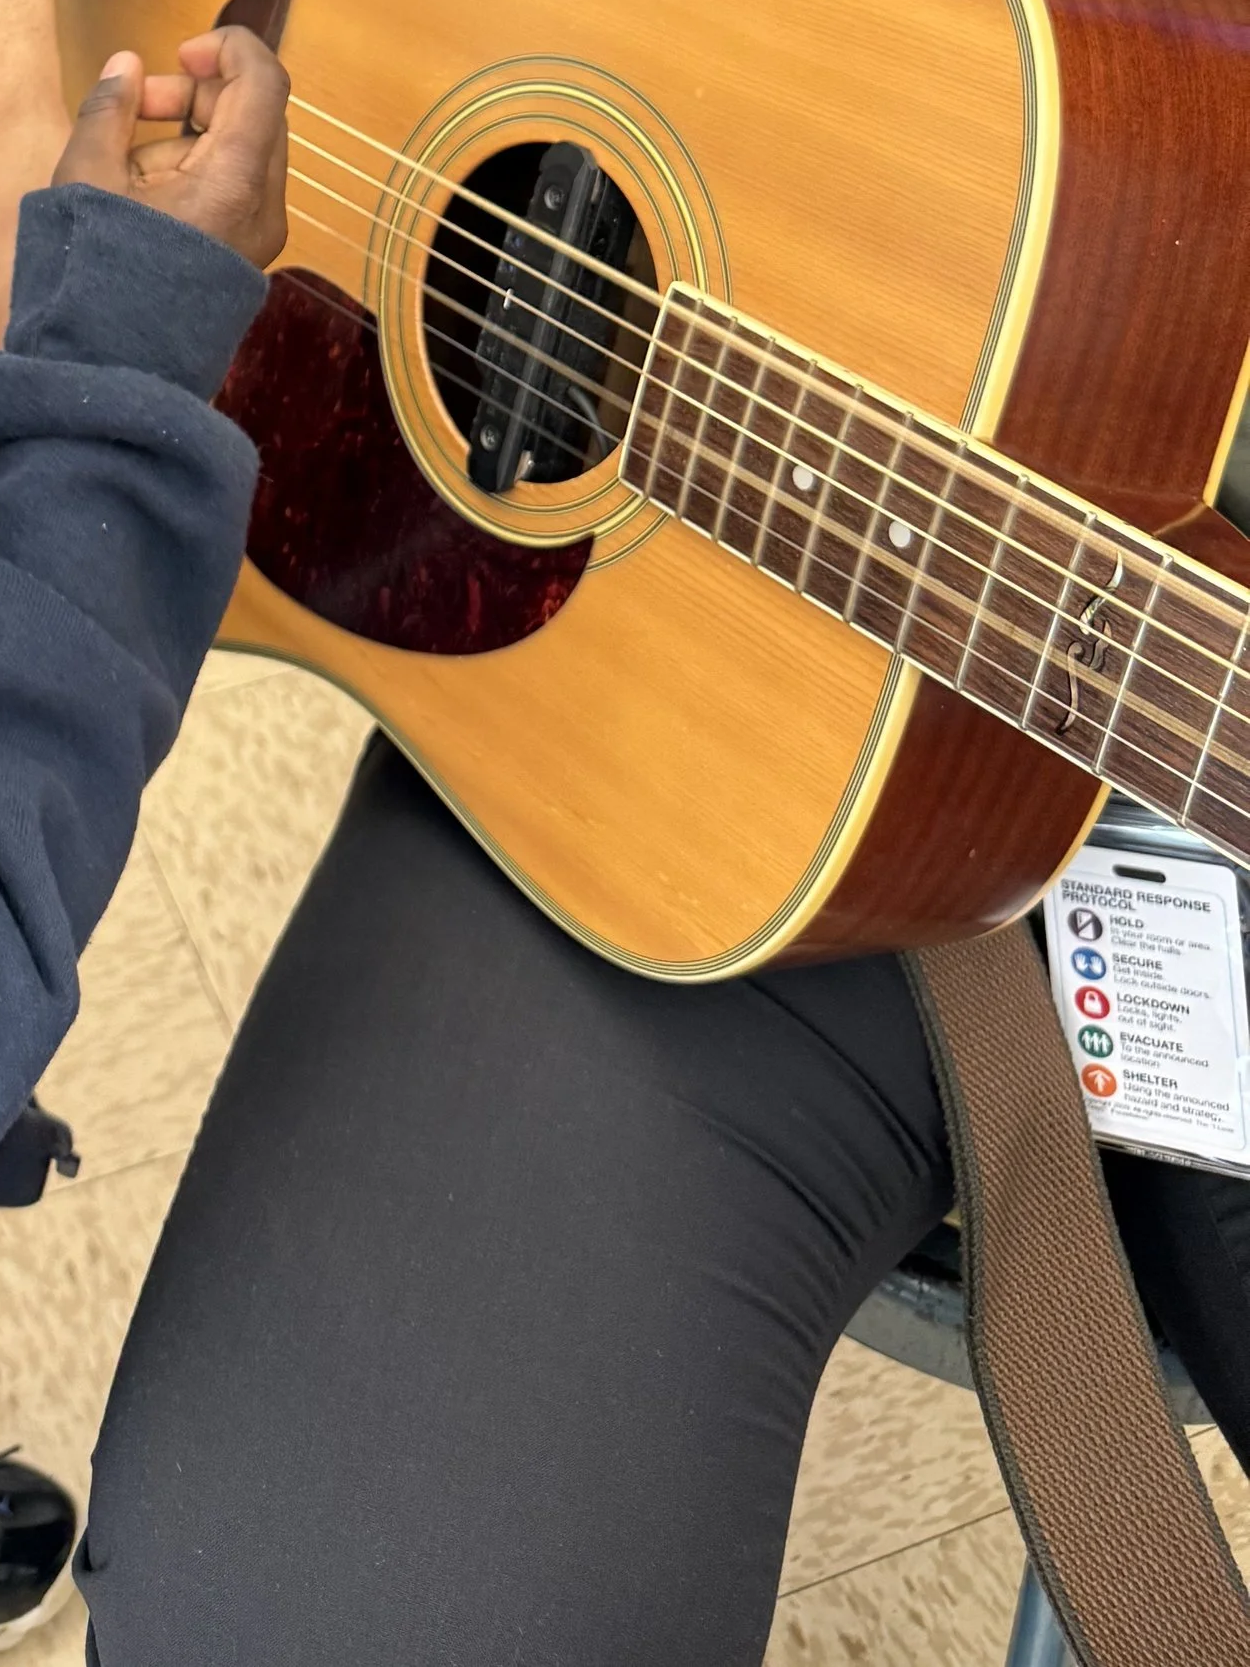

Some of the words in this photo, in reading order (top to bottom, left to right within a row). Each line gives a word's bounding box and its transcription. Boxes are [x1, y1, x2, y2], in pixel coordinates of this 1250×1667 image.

[1061, 878, 1133, 900] STANDARD
[1136, 891, 1212, 913] RESPONSE
[1062, 890, 1137, 912] PROTOCOL
[1110, 914, 1144, 929] HOLD
[1112, 952, 1163, 971] SECURE
[1116, 992, 1190, 1015] LOCKDOWN
[1120, 1032, 1184, 1053] EVACUATE
[1152, 1049, 1209, 1068] announced
[1123, 1069, 1178, 1090] SHELTER
[1173, 1091, 1230, 1112] announced
